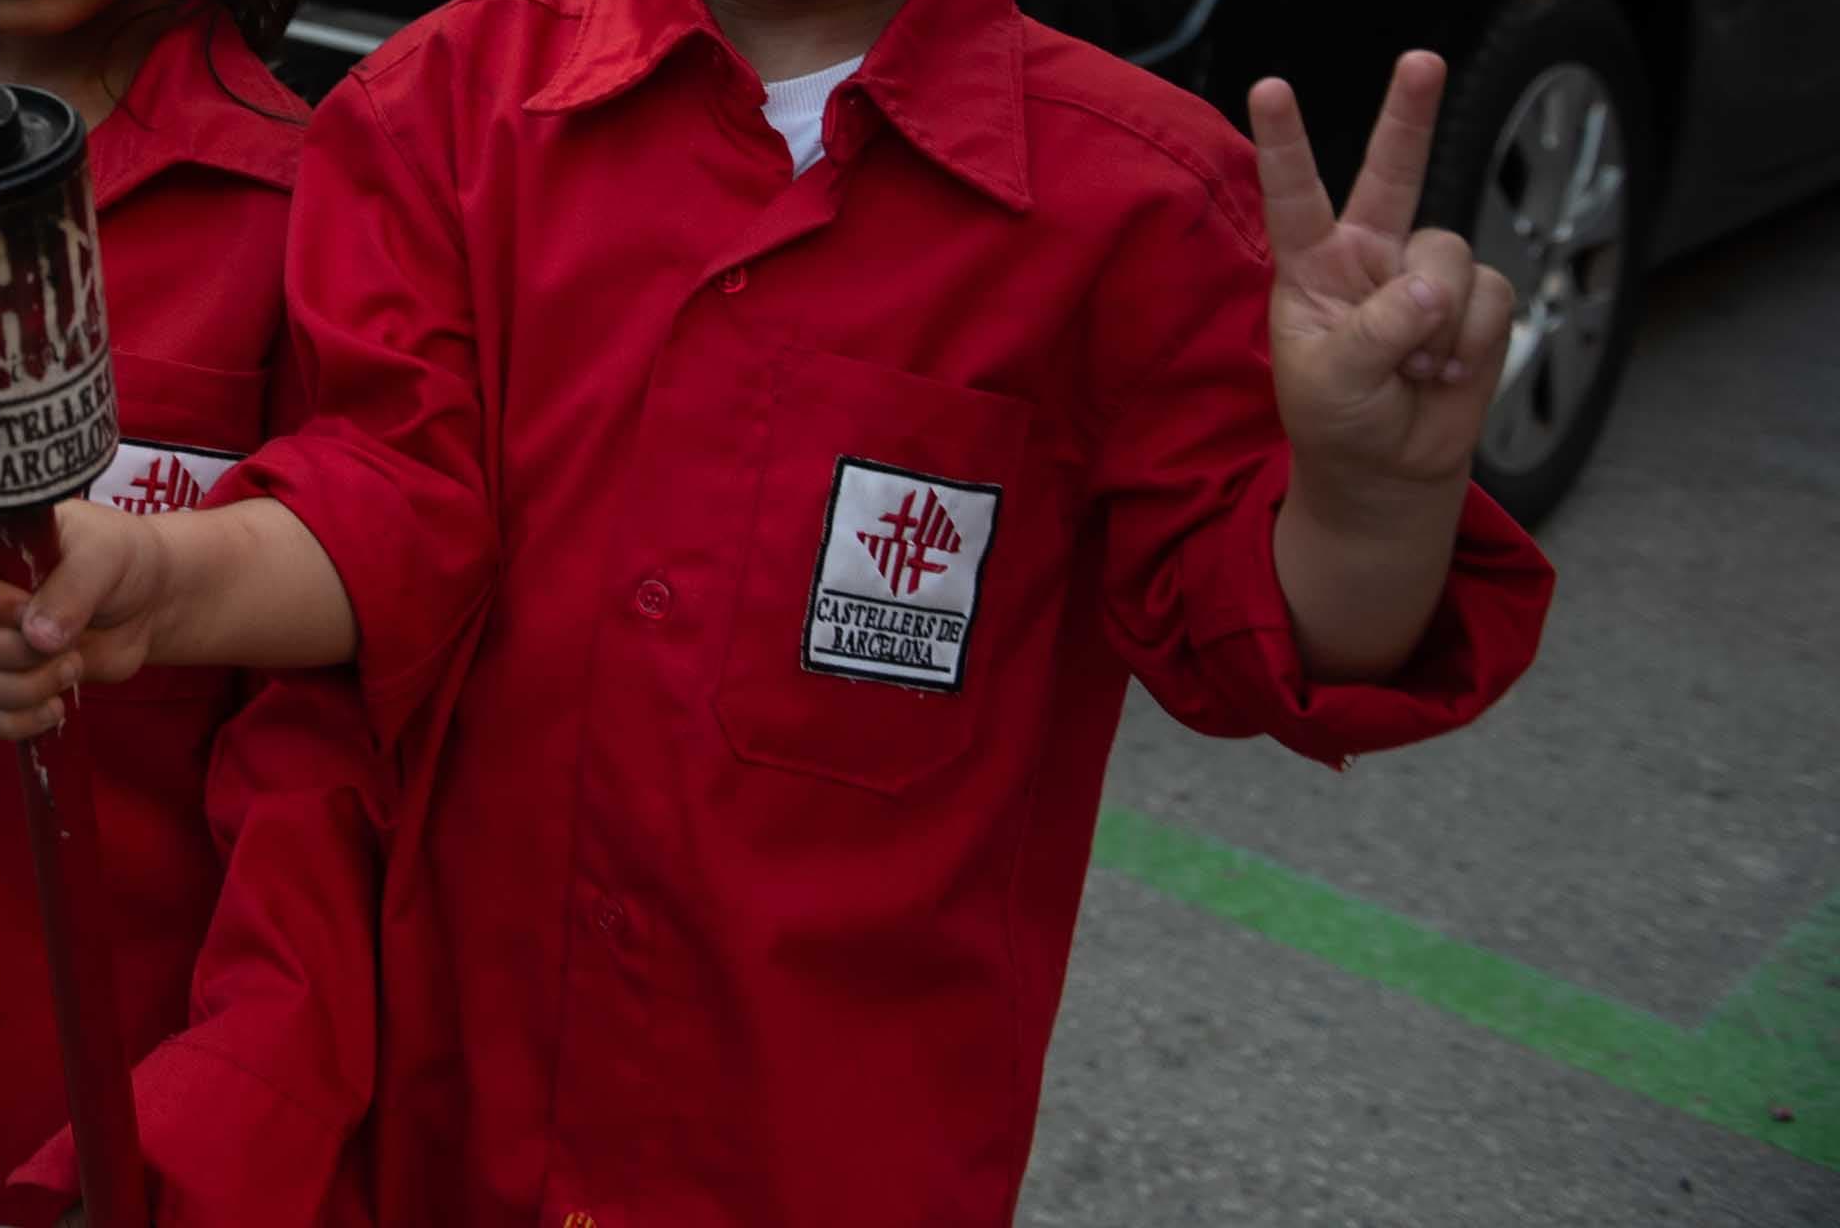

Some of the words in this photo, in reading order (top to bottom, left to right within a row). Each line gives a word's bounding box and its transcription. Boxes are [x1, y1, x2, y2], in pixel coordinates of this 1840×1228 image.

[816, 597, 937, 639] CASTELLERS
[936, 618, 963, 644] DE
[832, 625, 934, 666] BARCELONA
